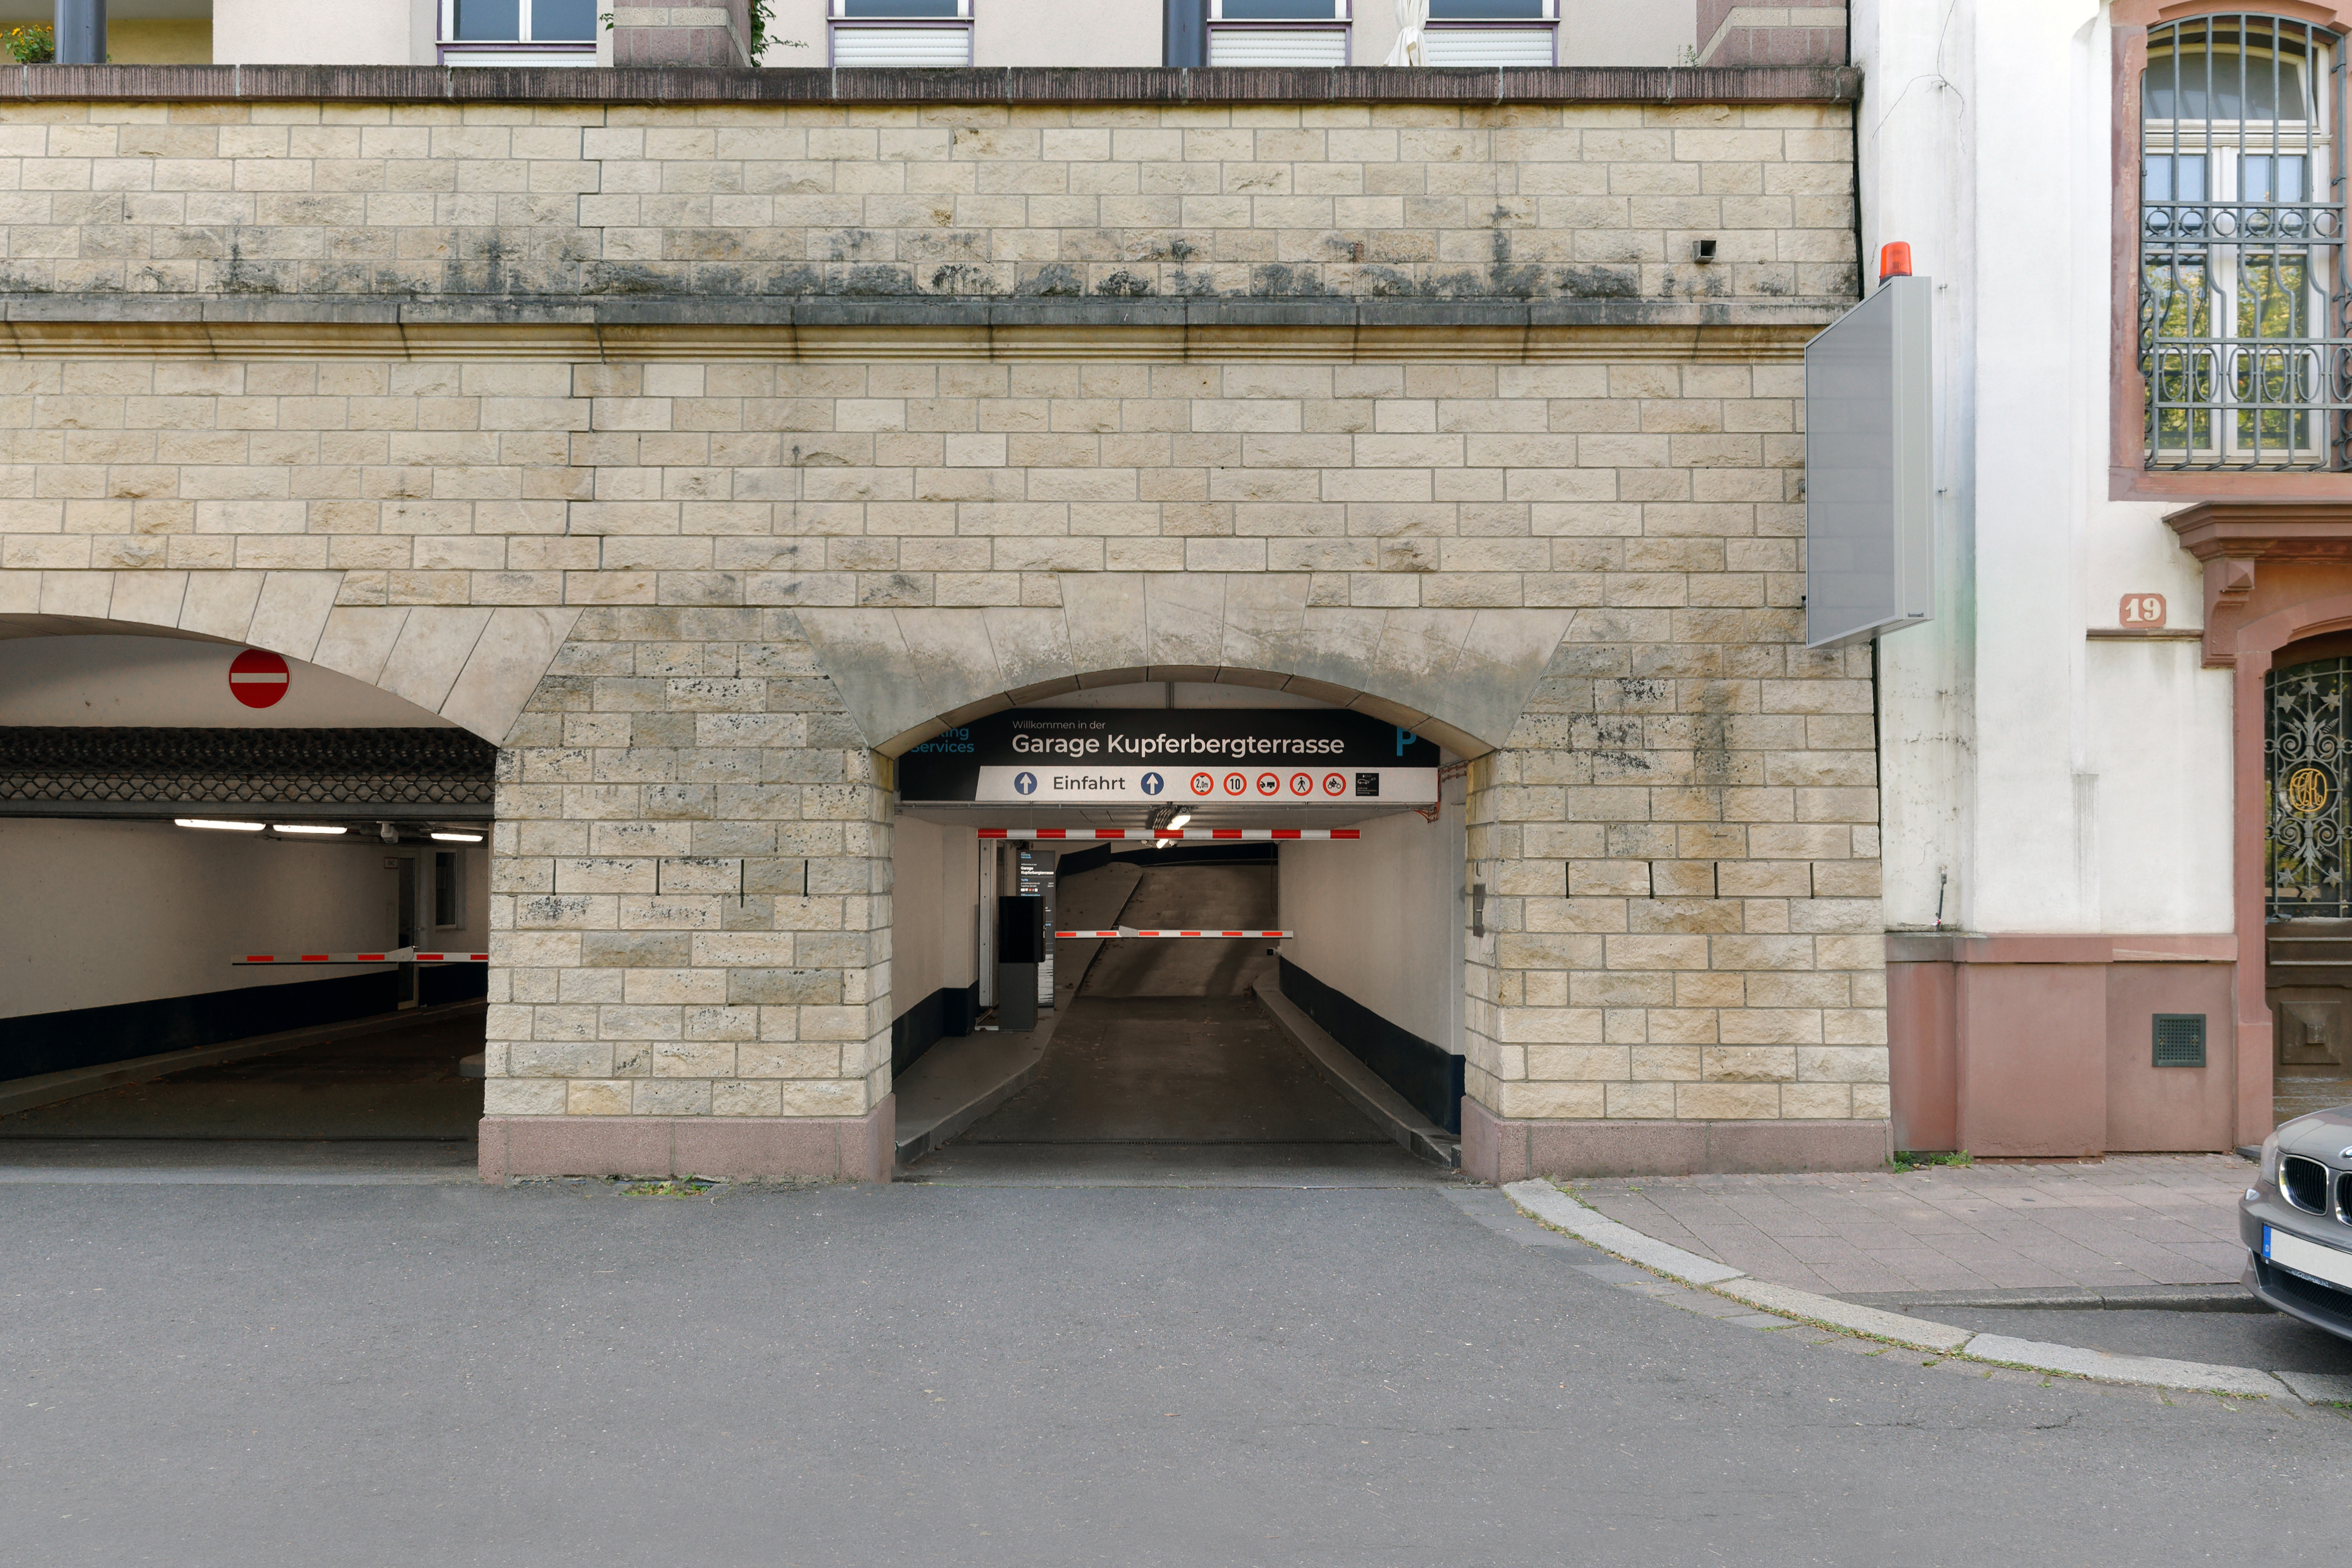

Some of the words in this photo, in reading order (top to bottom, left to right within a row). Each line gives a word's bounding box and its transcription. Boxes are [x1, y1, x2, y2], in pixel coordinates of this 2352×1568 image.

[2125, 598, 2161, 622] 19
[1012, 720, 1075, 729] Willkommen
[1078, 720, 1087, 729] in
[1089, 720, 1106, 729] der
[1012, 734, 1100, 758] Garage
[1108, 733, 1344, 758] Kupferbergterrasse
[1397, 726, 1417, 756] P
[1053, 776, 1126, 790] Einfahrt
[1196, 779, 1208, 788] 2,0m
[1230, 779, 1240, 790] 10
